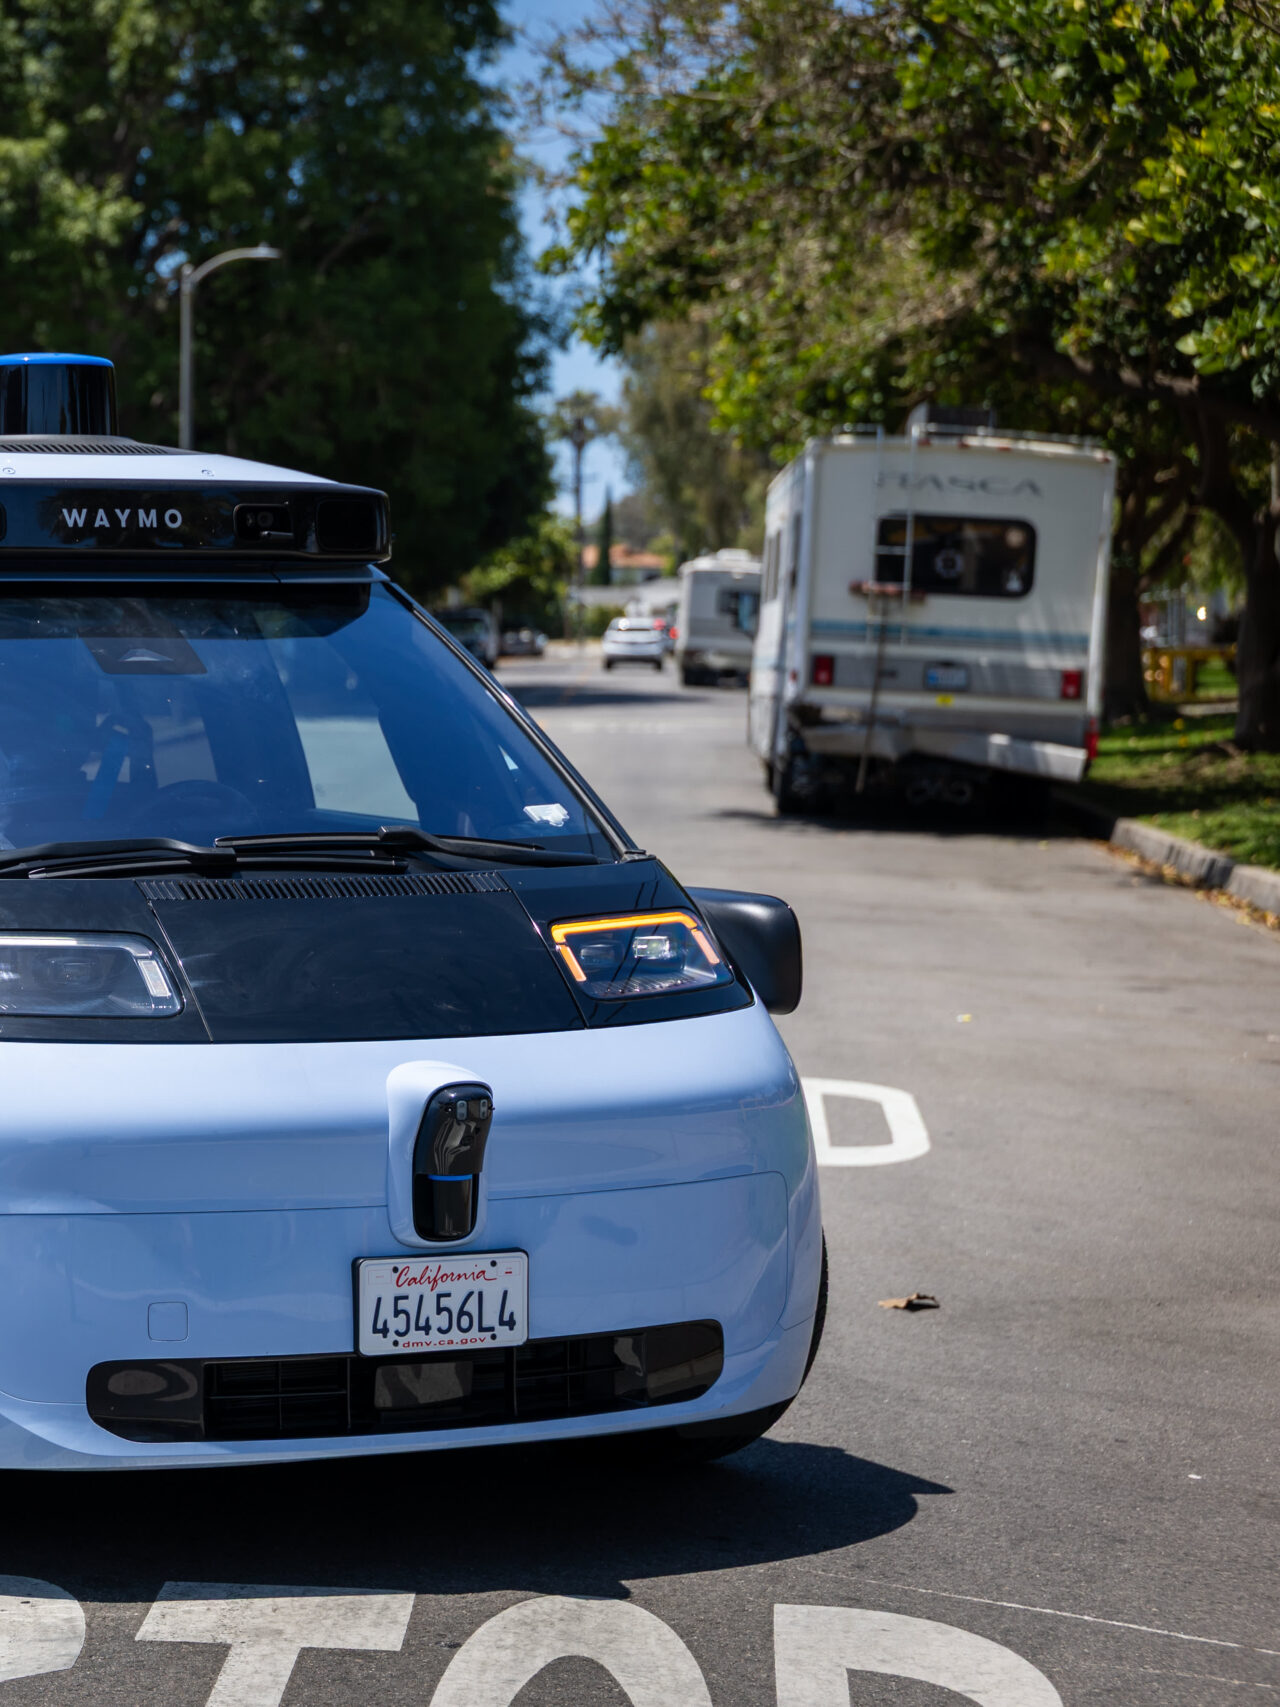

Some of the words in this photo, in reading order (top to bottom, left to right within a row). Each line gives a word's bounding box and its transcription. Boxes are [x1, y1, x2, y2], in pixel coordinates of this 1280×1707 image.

[62, 508, 183, 529] WAYMO
[395, 1264, 497, 1292] California
[372, 1289, 516, 1339] 45456L4
[402, 1336, 487, 1349] dmv.ca.gov
